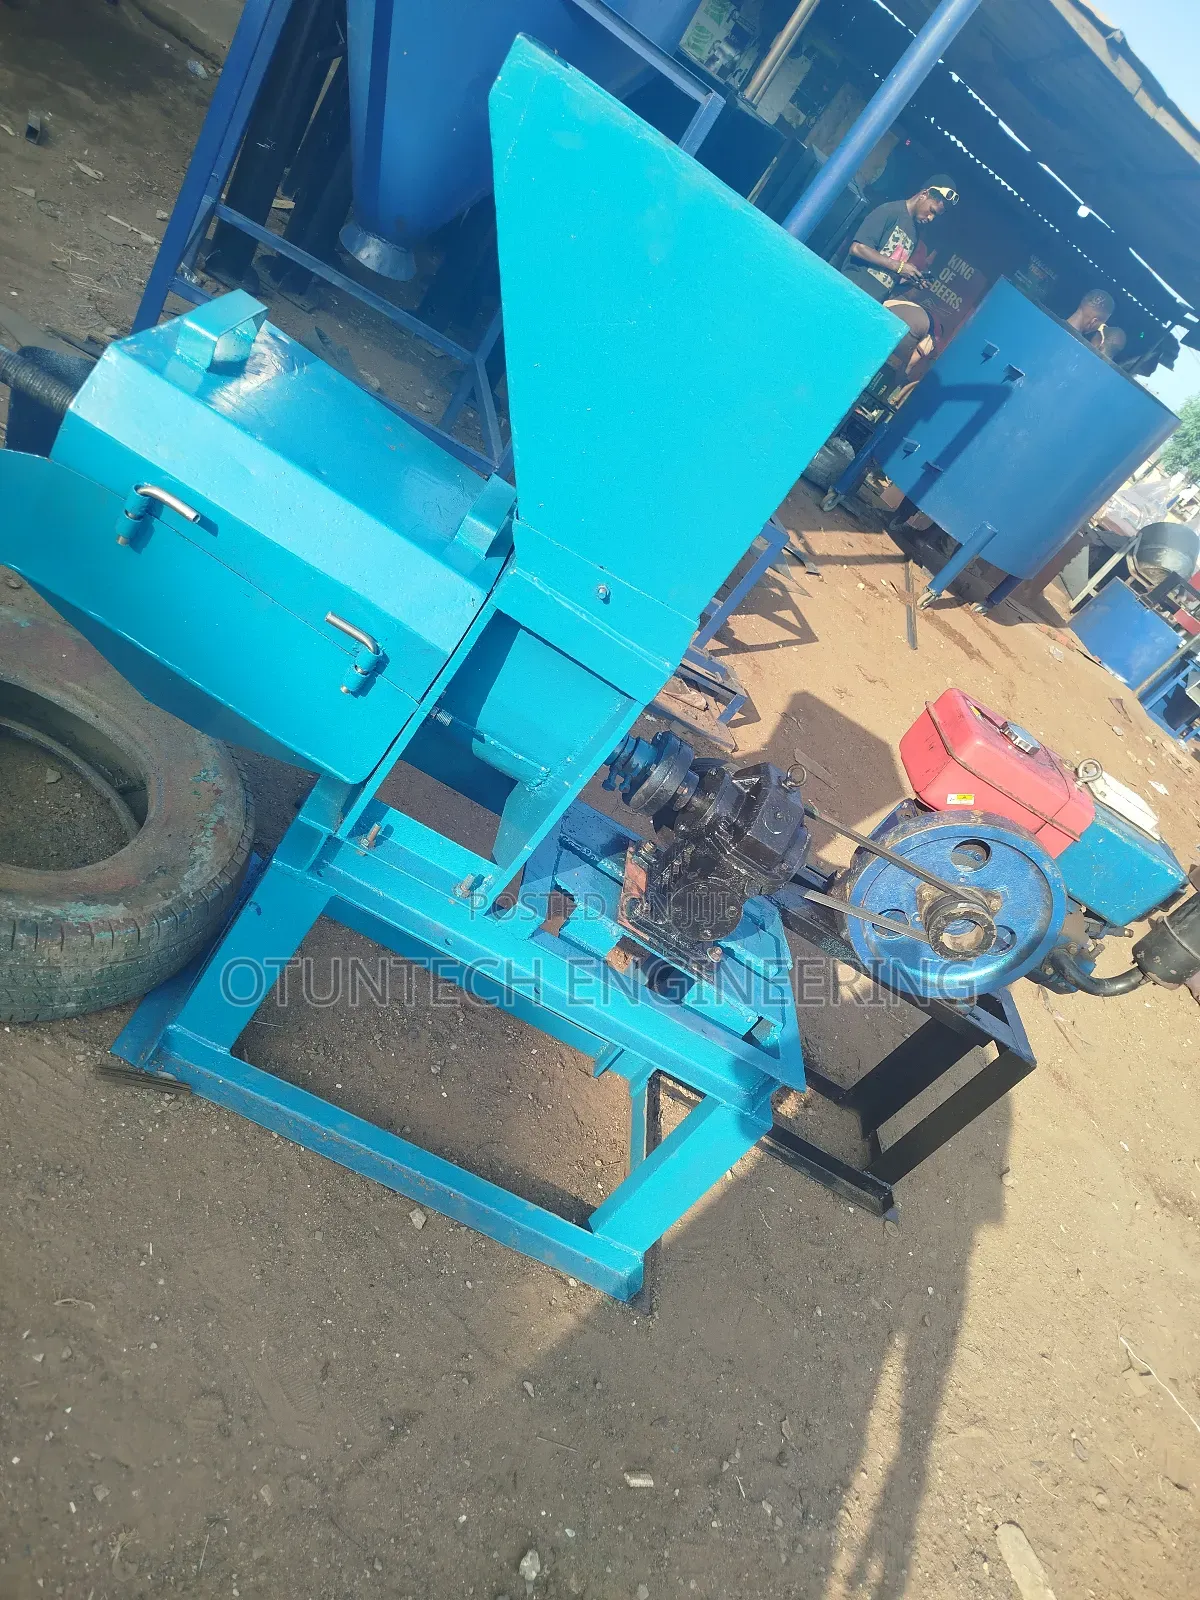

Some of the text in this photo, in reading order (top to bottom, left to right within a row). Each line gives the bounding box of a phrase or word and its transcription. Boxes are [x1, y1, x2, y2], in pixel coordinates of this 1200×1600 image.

[938, 267, 956, 284] OF
[947, 254, 975, 280] KING
[930, 281, 962, 312] BEERS.
